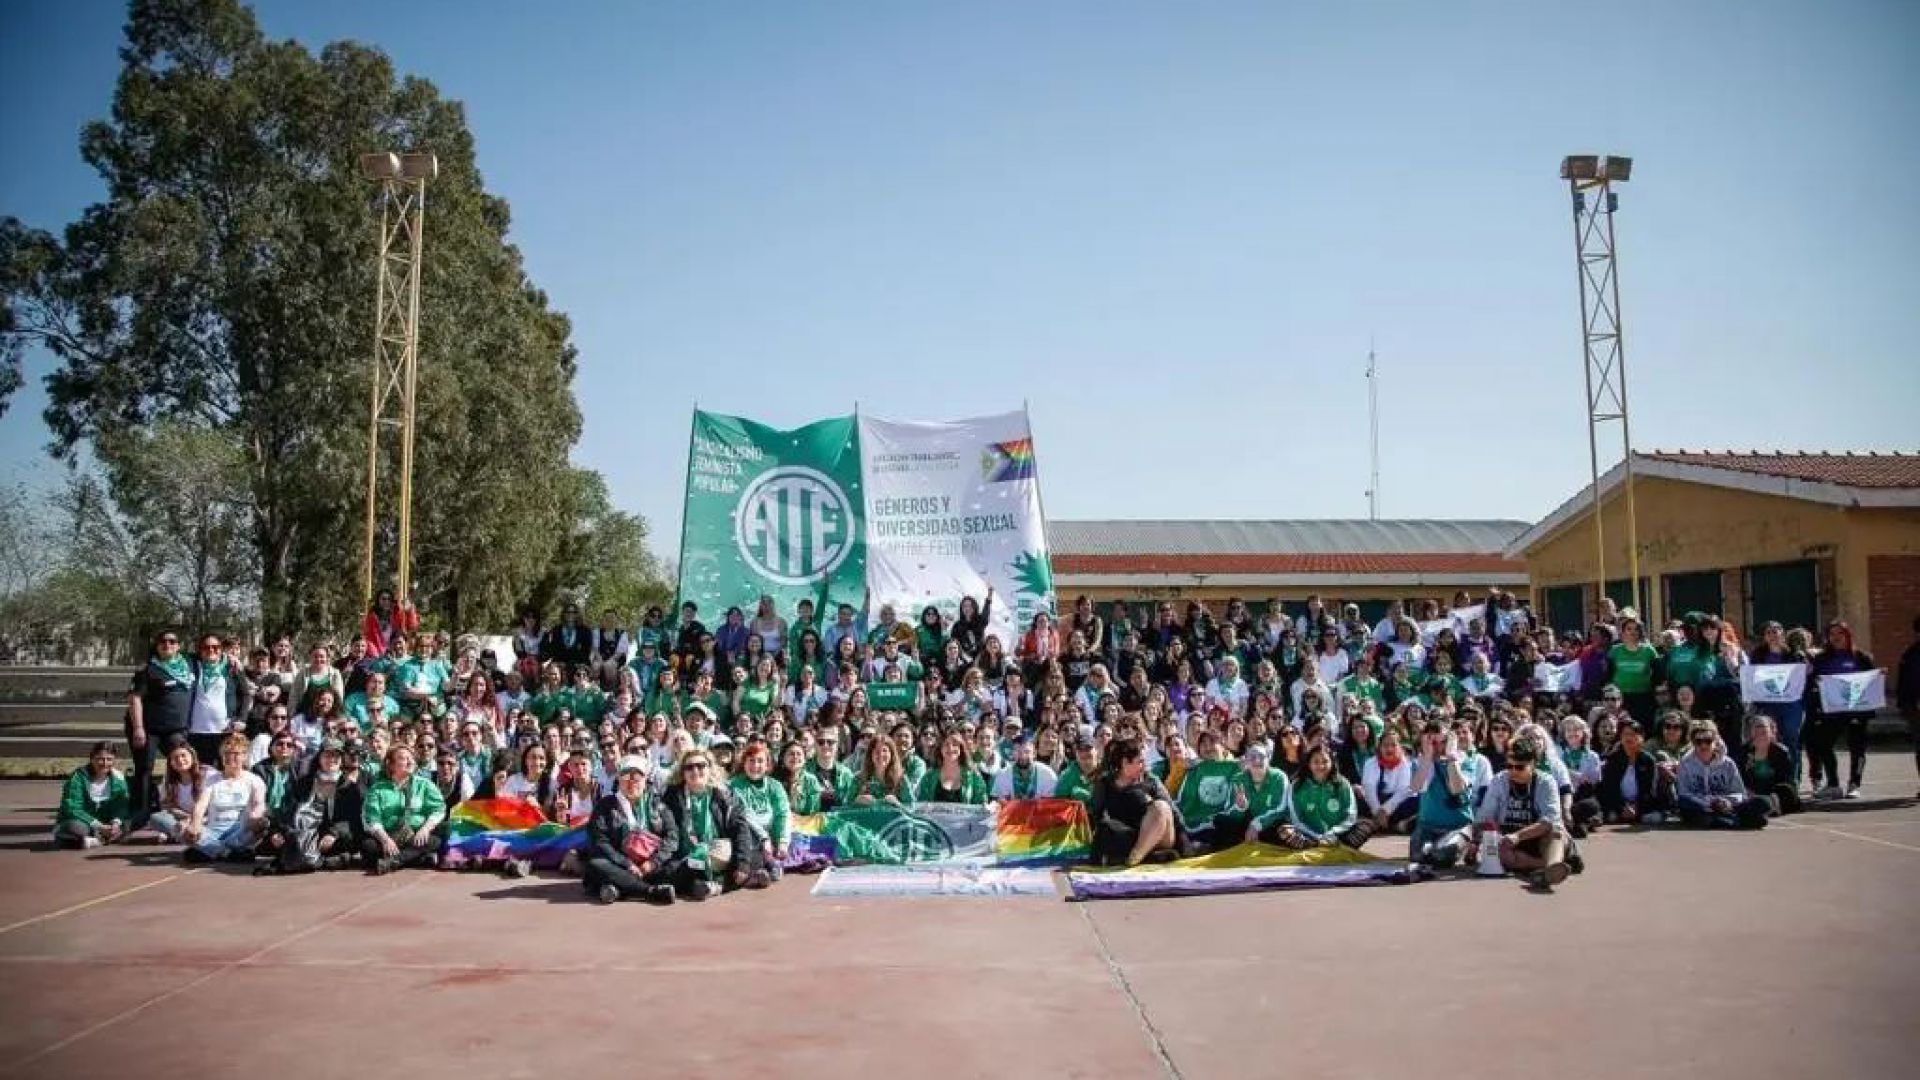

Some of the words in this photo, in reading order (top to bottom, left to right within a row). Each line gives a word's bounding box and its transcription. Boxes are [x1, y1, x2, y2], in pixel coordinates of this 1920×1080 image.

[940, 497, 951, 513] Y
[745, 478, 841, 577] ATE
[877, 518, 960, 537] DIVERSIDAD
[963, 513, 1018, 533] SEXUAL
